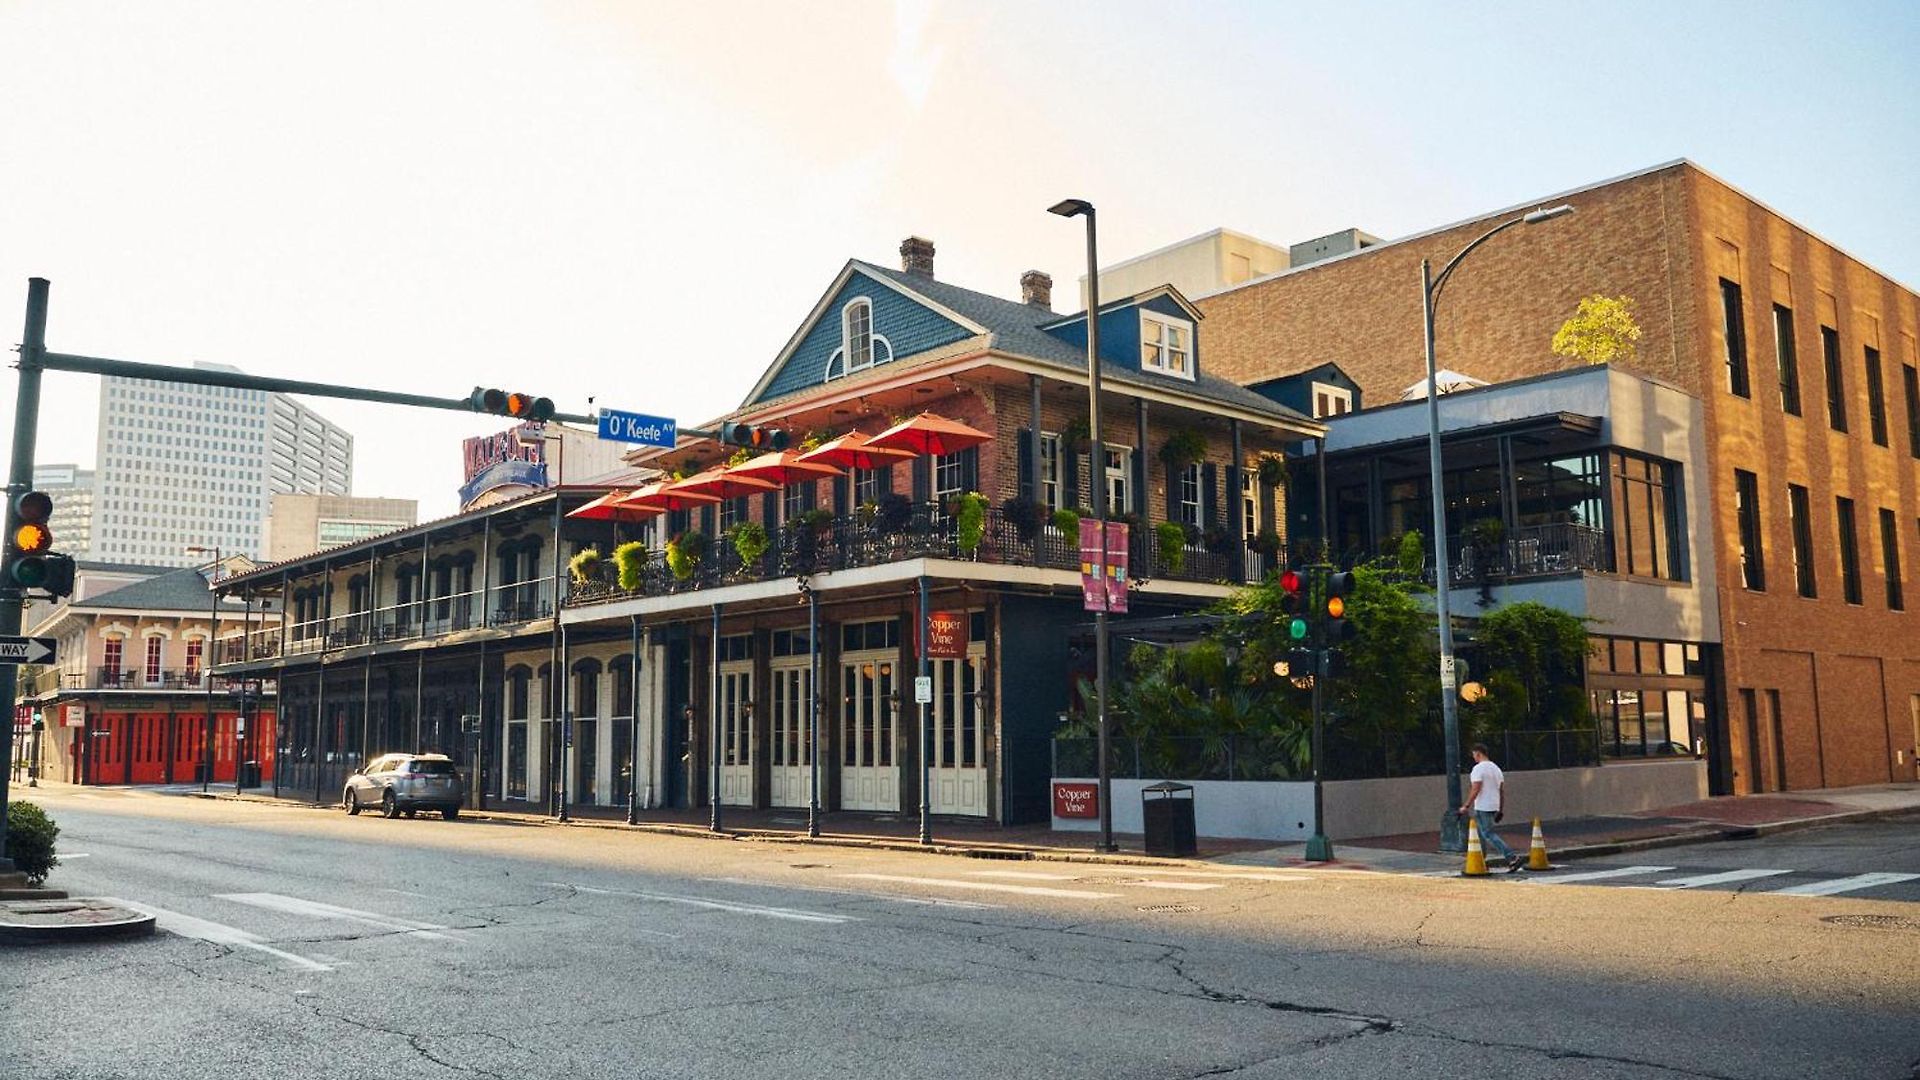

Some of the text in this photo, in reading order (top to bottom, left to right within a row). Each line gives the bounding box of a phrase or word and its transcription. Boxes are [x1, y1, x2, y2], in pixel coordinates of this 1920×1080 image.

[609, 415, 674, 441] O'Keefe AV
[931, 631, 953, 645] Vine
[2, 644, 27, 655] WAY
[1058, 787, 1091, 802] Copper
[1065, 801, 1085, 813] Vine
